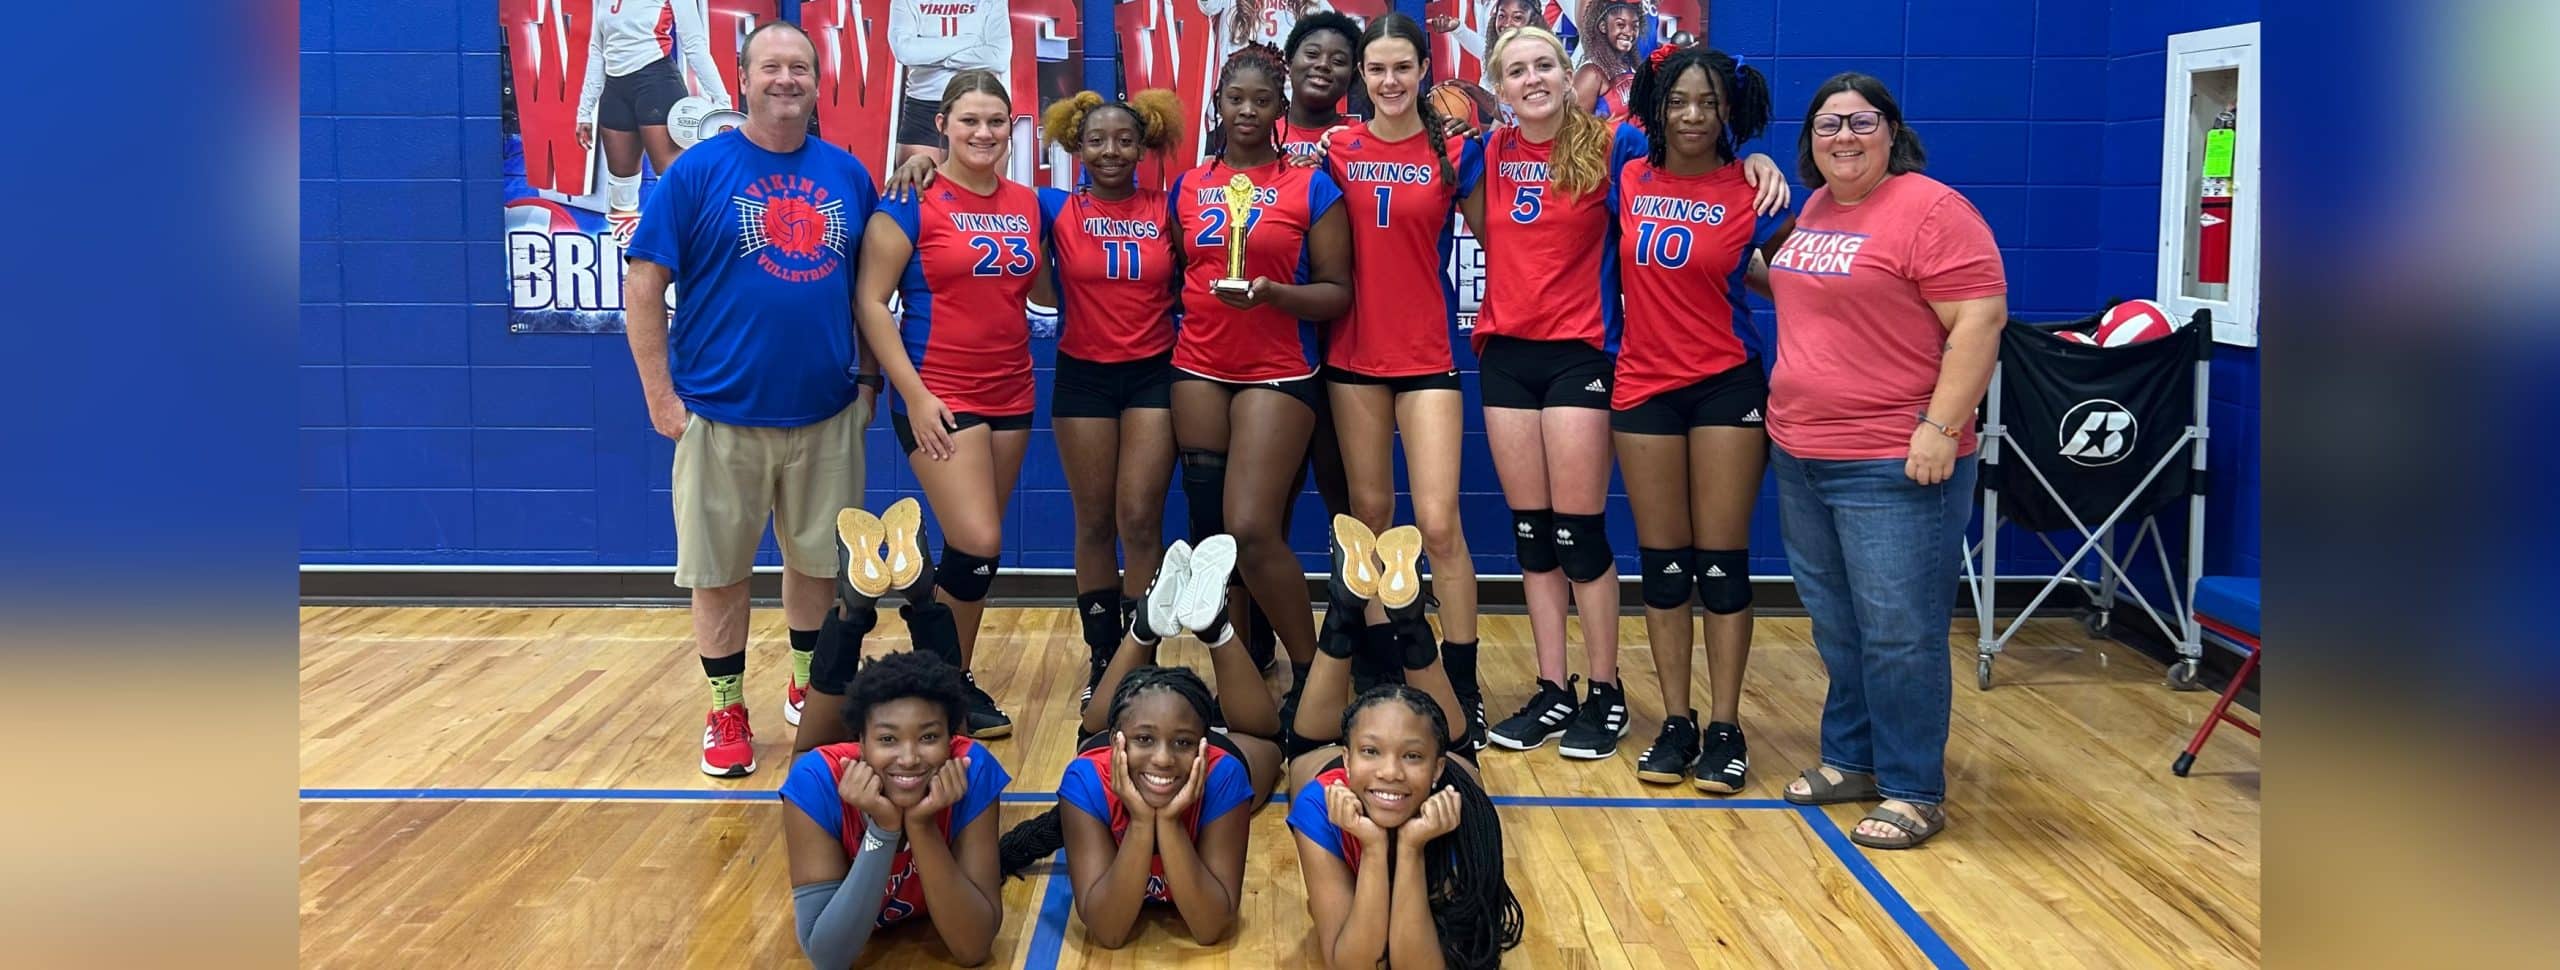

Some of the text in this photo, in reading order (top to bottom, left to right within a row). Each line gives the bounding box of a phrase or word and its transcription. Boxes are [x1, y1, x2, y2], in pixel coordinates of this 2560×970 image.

[919, 3, 977, 15] VIKINGS
[1264, 10, 1278, 37] 5
[941, 16, 958, 37] 11
[1347, 161, 1432, 185] VIKINGS
[1499, 161, 1557, 183] VIKIN
[744, 173, 829, 206] VIKING
[1197, 186, 1279, 207] VIKGS
[1374, 185, 1393, 229] 1
[1510, 186, 1544, 225] 5
[1631, 195, 1726, 226] VIKINGS
[950, 211, 1031, 234] VIKINGS
[1083, 216, 1160, 240] VIKINGS
[1196, 206, 1264, 248] 27
[968, 234, 1036, 277] 23
[1635, 220, 1694, 270] 10
[758, 253, 838, 282] VOLLEYBALL
[1102, 240, 1142, 281] 11
